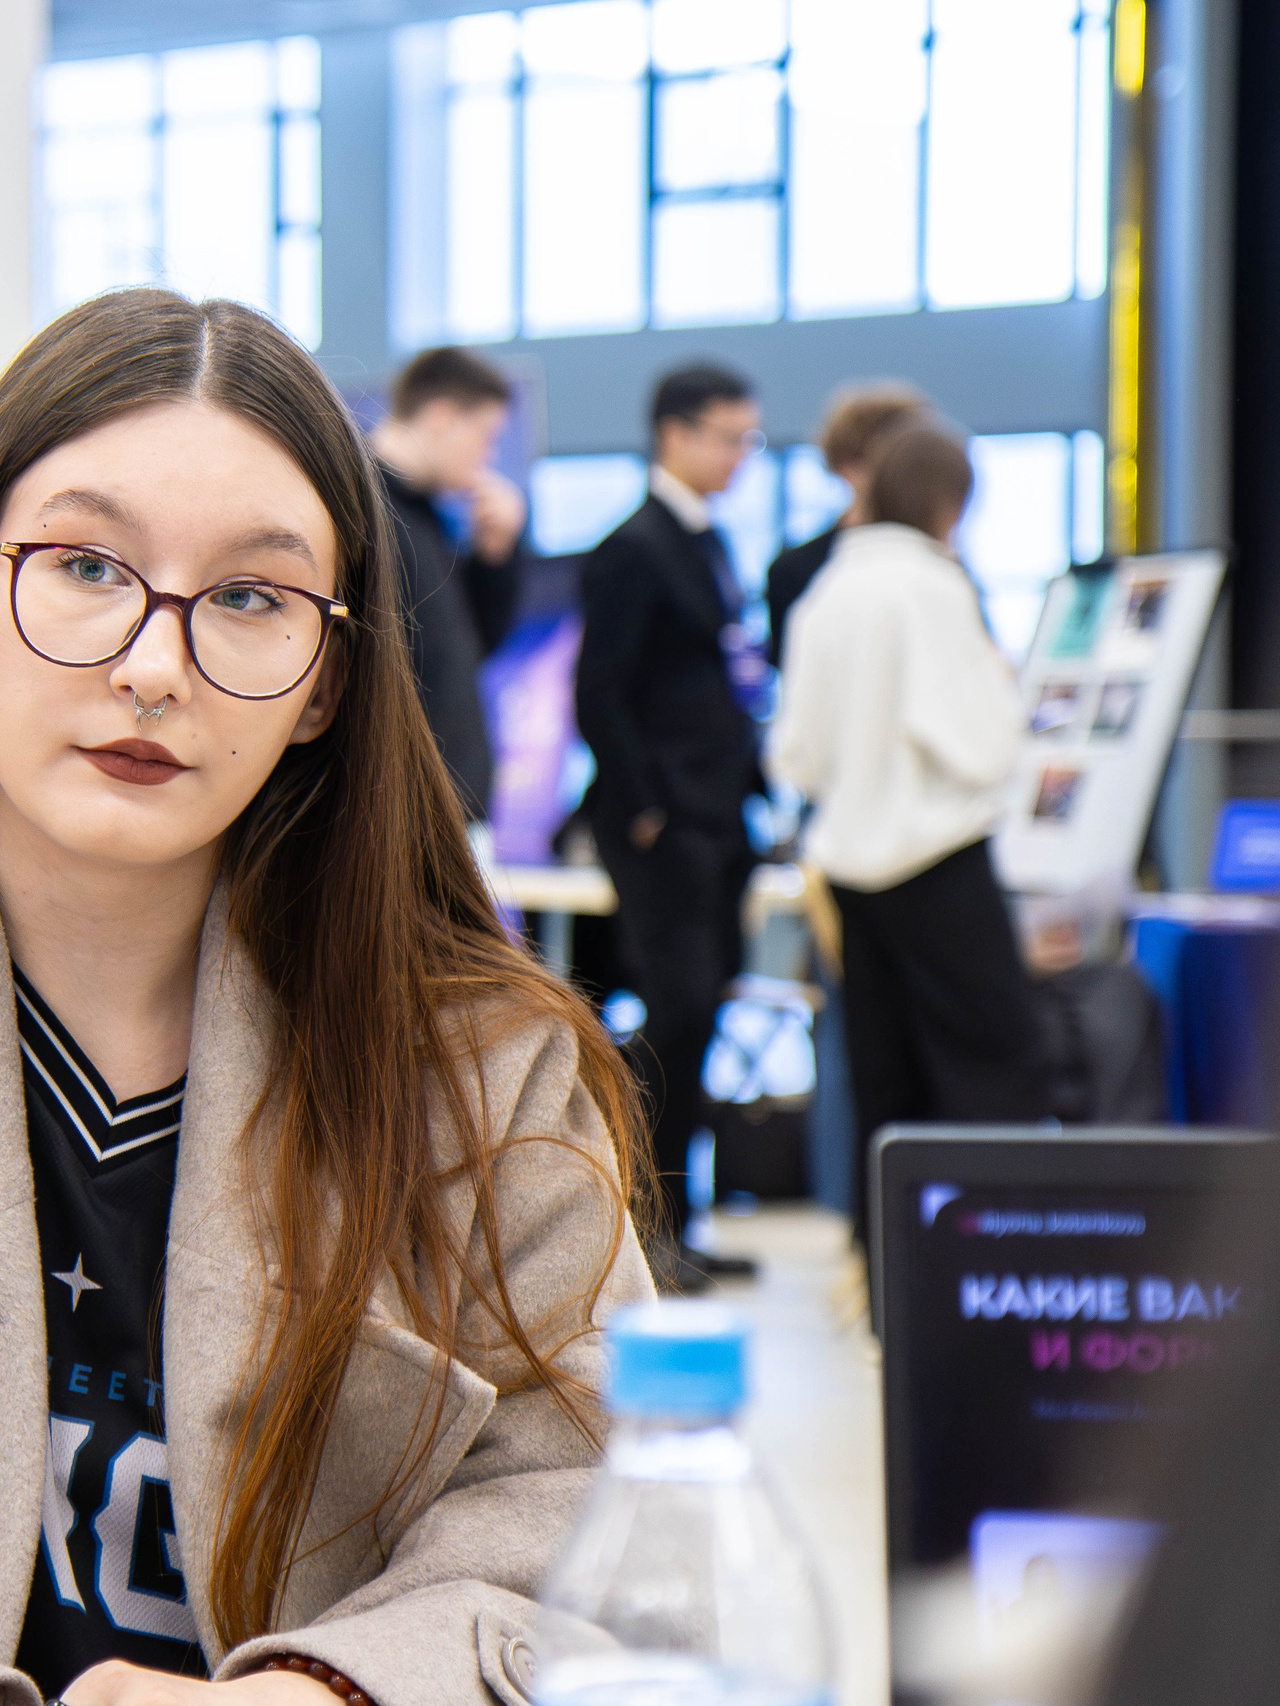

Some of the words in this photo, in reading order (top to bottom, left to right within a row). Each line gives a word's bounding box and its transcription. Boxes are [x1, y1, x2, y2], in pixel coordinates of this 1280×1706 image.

[960, 1274, 1129, 1321] КАКИЕ
[1031, 1330, 1070, 1371] И
[1080, 1331, 1208, 1372] ФОР
[47, 1355, 163, 1407] EET
